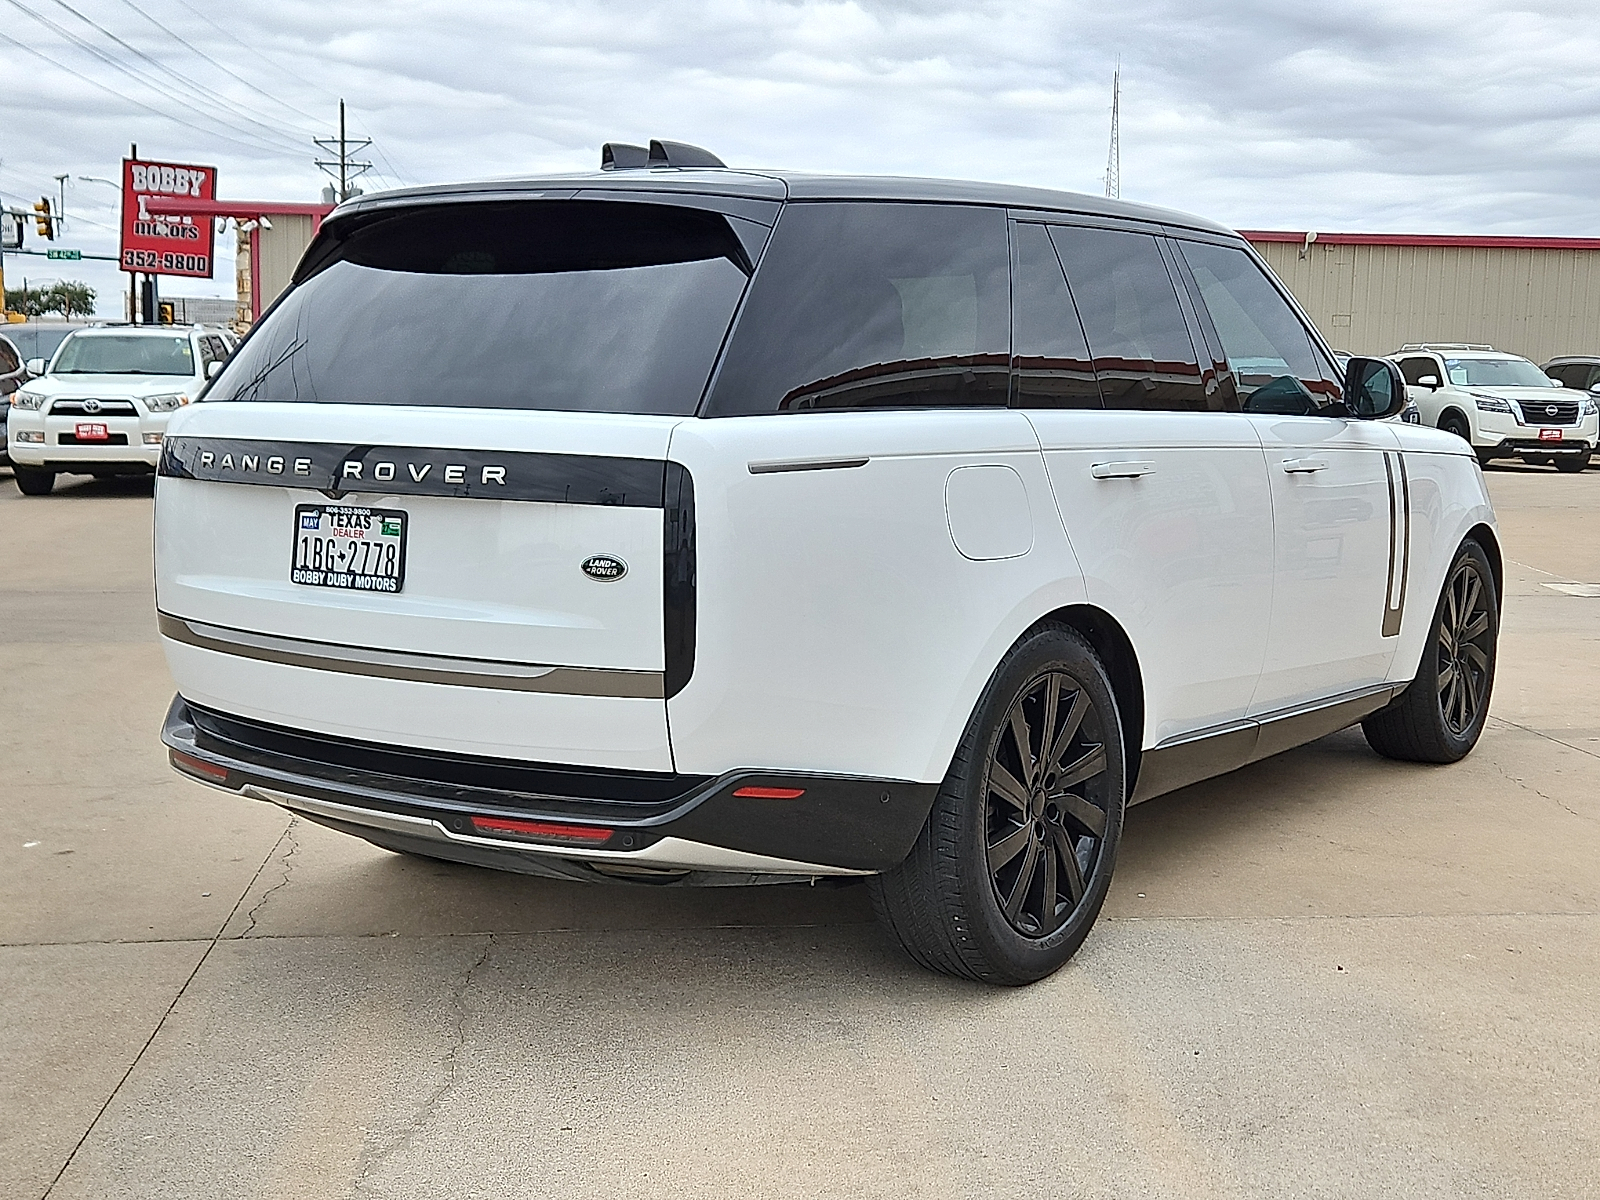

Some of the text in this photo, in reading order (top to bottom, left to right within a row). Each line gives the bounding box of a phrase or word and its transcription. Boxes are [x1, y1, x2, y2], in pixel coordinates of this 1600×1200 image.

[132, 165, 205, 196] BOBBY
[124, 249, 207, 272] 352-9800
[200, 451, 507, 486] RANGE ROVER
[303, 517, 318, 528] MAY
[329, 513, 372, 530] TEXAS
[333, 528, 365, 539] DEALER
[300, 536, 396, 577] 1BG 2778
[293, 570, 397, 591] BOBBY DUBY MOTORS
[590, 567, 618, 576] ROVER
